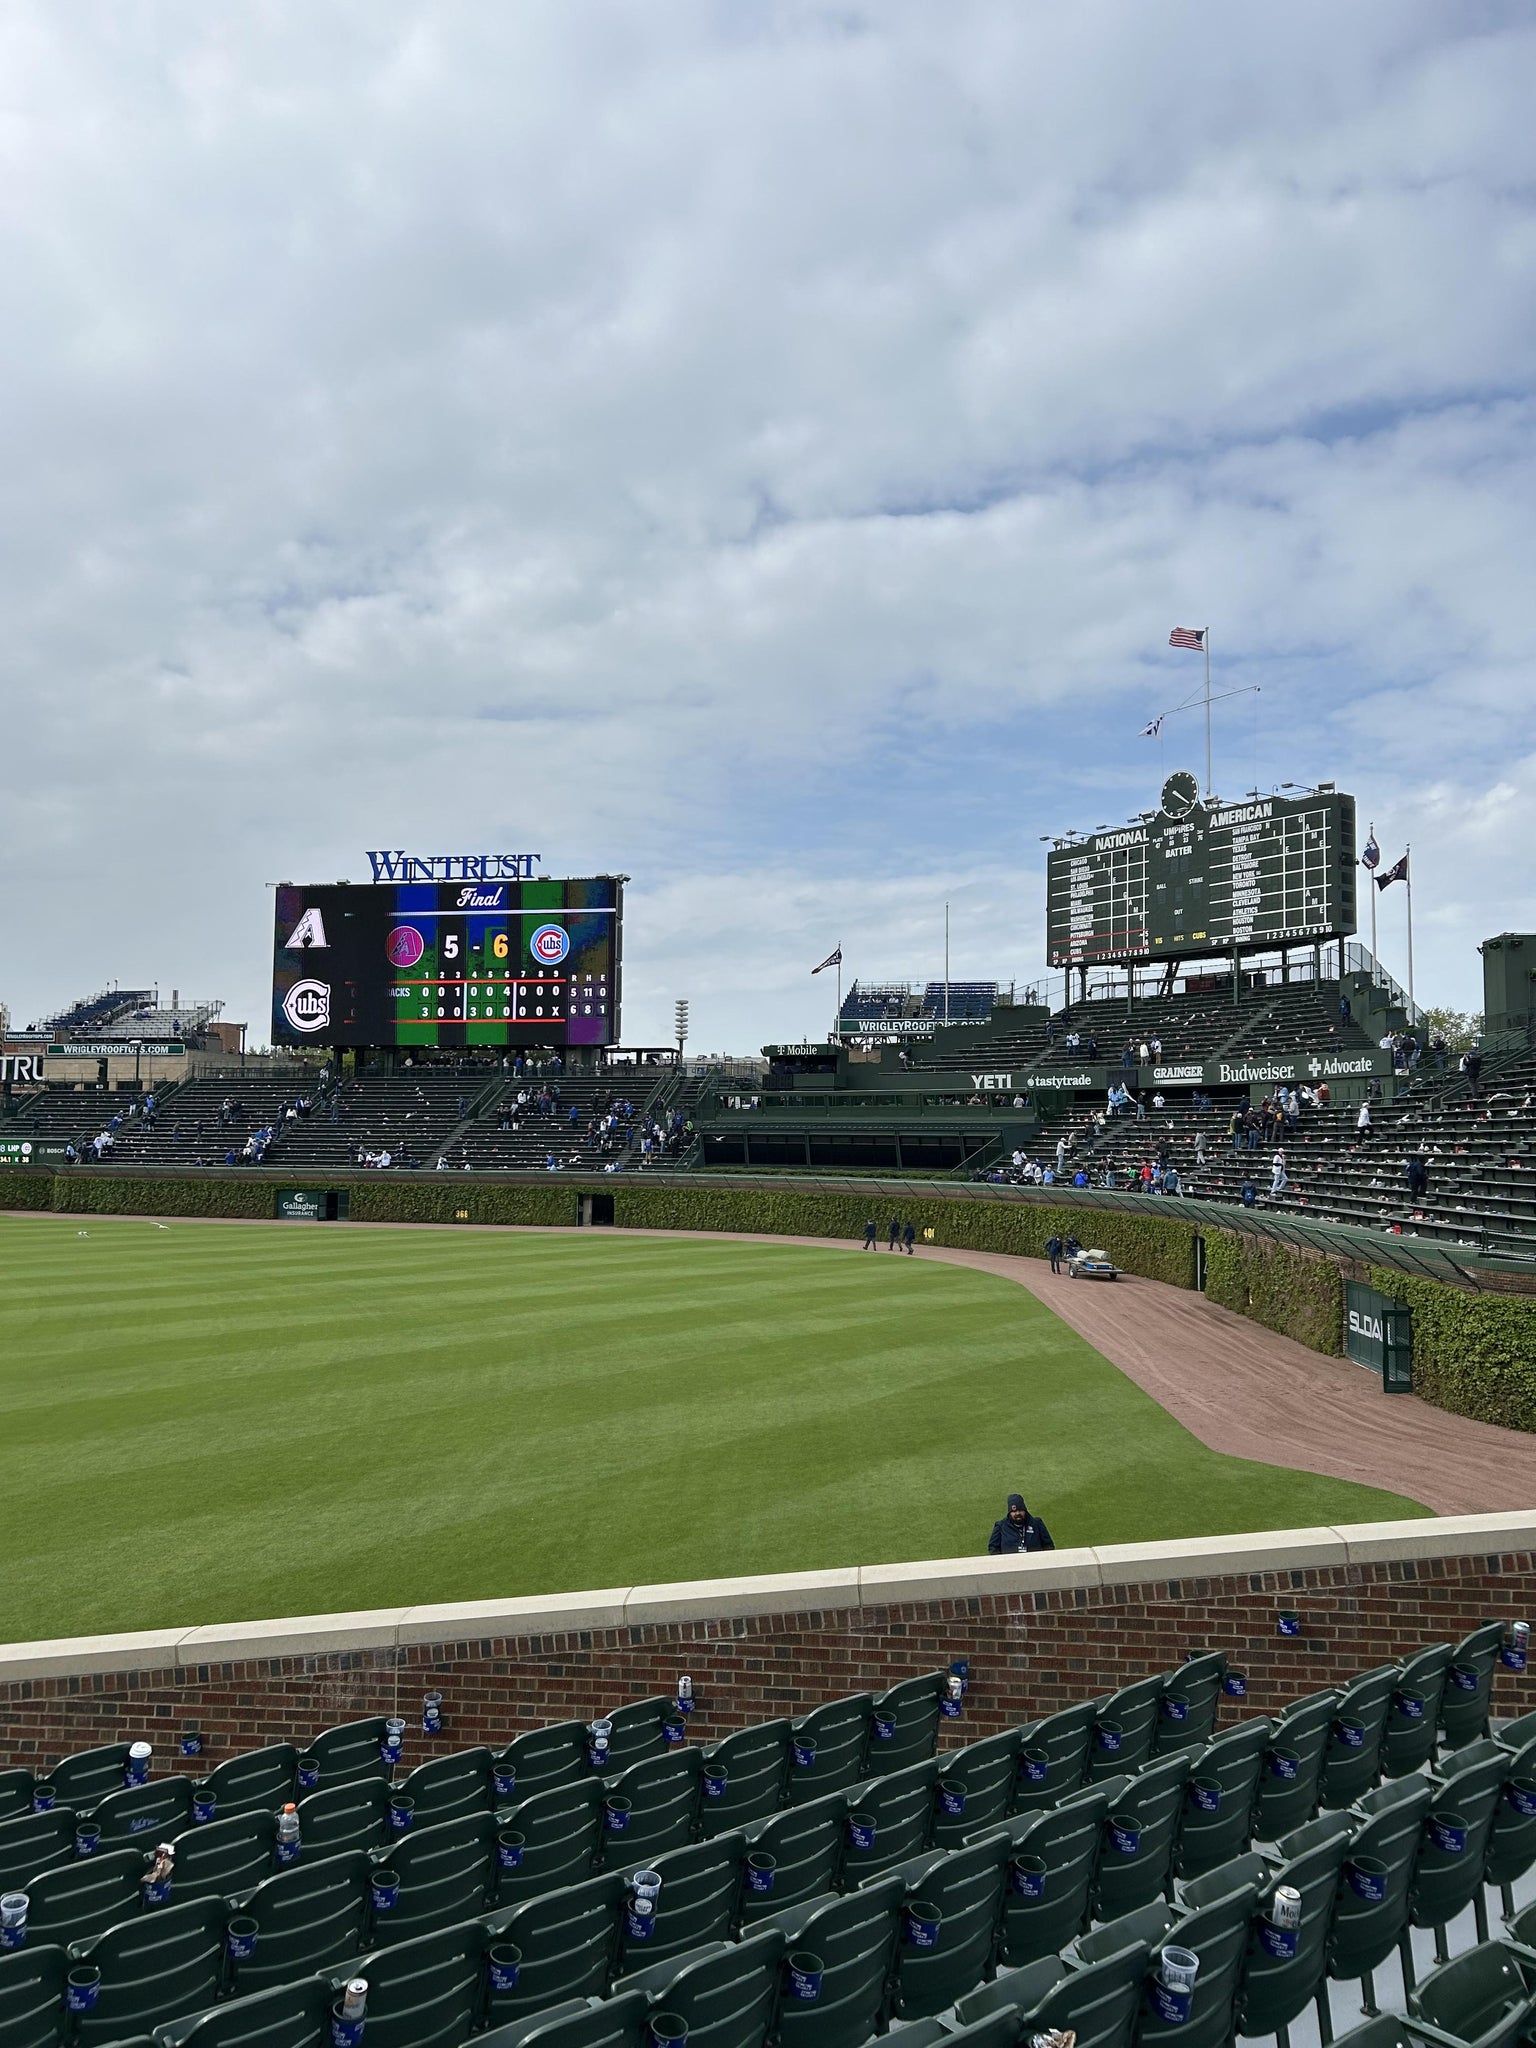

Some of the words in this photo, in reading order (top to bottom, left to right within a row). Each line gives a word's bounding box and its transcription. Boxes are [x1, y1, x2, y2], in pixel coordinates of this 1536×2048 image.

[1209, 802, 1273, 828] AMERICAN
[1163, 822, 1195, 836] UMPIRES
[1095, 828, 1149, 851] NATIONAL
[1232, 836, 1249, 846] TAMPA
[1249, 833, 1261, 842] BAY
[1165, 846, 1193, 858] BATTER
[1232, 845, 1247, 854] TEXAS
[1232, 853, 1253, 863] DETROIT
[366, 850, 541, 882] WINTRUST
[1232, 861, 1260, 871] BALTIMORE
[1188, 876, 1204, 885] STRIKE
[1232, 872, 1242, 881] NEW
[1243, 870, 1256, 879] YORK
[1232, 879, 1256, 890] TORONTO
[457, 887, 503, 907] Final
[1232, 888, 1261, 899] MINNESOTA
[1232, 897, 1261, 907] CLEVELAND
[1232, 905, 1258, 916] ATHLETICS
[1232, 916, 1254, 926] HOUSTON
[1192, 931, 1207, 940] CUBS
[1232, 925, 1253, 935] BOSTON
[1279, 931, 1284, 939] 3
[1285, 930, 1291, 938] 4
[1292, 929, 1298, 937] 5
[1299, 929, 1304, 937] 6
[1305, 927, 1311, 936] 7
[1312, 927, 1318, 935] 8
[1319, 926, 1324, 935] 9
[1325, 925, 1333, 934] 10
[443, 934, 459, 958] 5
[494, 934, 508, 958] 6
[1070, 947, 1082, 956] CUBS
[1107, 952, 1112, 960] 3
[1112, 951, 1117, 959] 4
[1128, 949, 1133, 957] 7
[1139, 948, 1143, 956] 9
[1144, 947, 1150, 955] 10
[424, 971, 429, 979] 1
[439, 971, 445, 979] 2
[455, 971, 461, 979] 3
[472, 971, 478, 979] 4
[537, 970, 543, 978] 8
[387, 988, 410, 997] ACKS
[422, 987, 430, 997] 0
[438, 987, 445, 997] 0
[454, 987, 460, 997] 1
[471, 986, 478, 997] 0
[487, 986, 494, 997] 0
[503, 986, 511, 996] 4
[520, 986, 527, 996] 0
[537, 986, 544, 996] 0
[553, 986, 560, 996] 0
[571, 988, 577, 997] 5
[584, 987, 593, 996] 11
[600, 987, 606, 996] 0
[422, 1007, 429, 1017] 3
[437, 1007, 445, 1017] 0
[453, 1007, 460, 1017] 0
[470, 1007, 477, 1017] 3
[486, 1006, 493, 1016] 0
[503, 1006, 510, 1016] 0
[519, 1006, 526, 1016] 0
[536, 1006, 543, 1016] 0
[552, 1006, 560, 1016] X
[571, 1005, 577, 1014] 6
[585, 1005, 593, 1014] 8
[600, 1005, 605, 1013] 1
[787, 1045, 818, 1056] Mobile
[1219, 1061, 1294, 1082] Budweiser
[1323, 1057, 1373, 1075] Advocate
[1153, 1065, 1204, 1079] GRAINGER
[972, 1074, 1012, 1089] YETI
[1035, 1074, 1092, 1089] tastytrade
[282, 1201, 318, 1211] Gallagher
